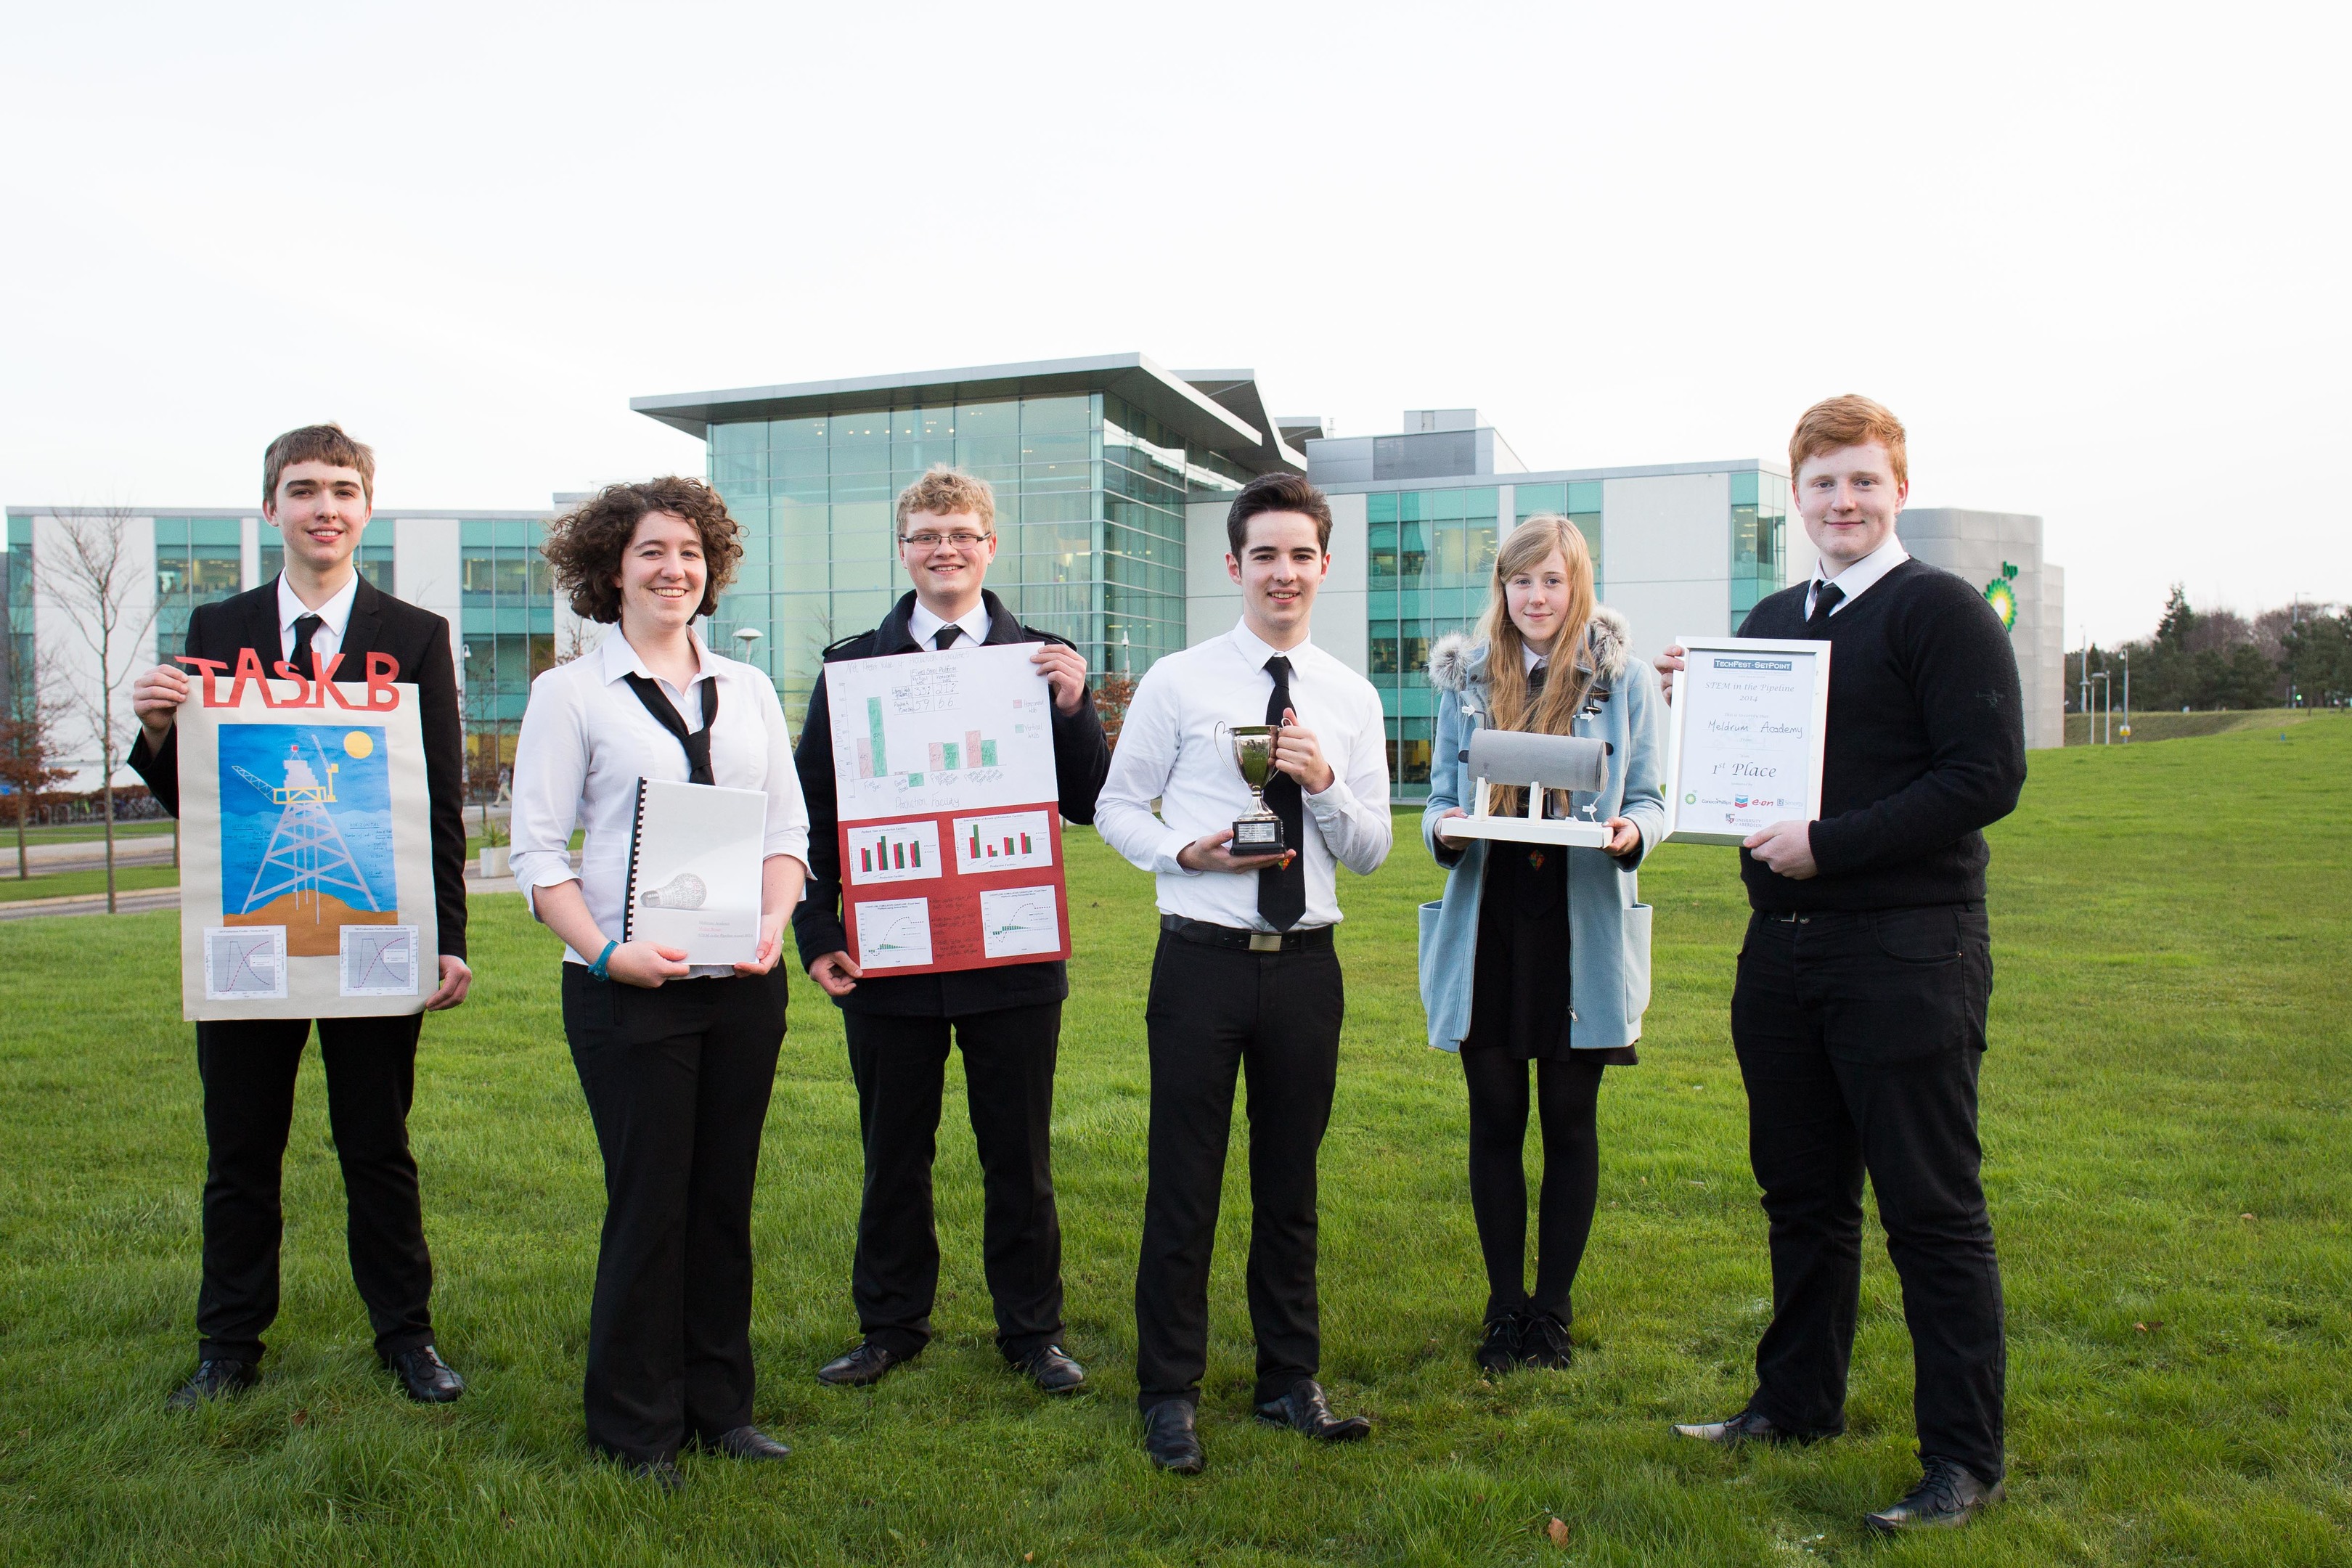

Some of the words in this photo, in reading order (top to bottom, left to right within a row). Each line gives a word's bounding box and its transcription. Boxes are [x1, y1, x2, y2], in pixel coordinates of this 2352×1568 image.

[2003, 560, 2018, 580] bp
[174, 648, 348, 709] TASK
[366, 652, 399, 711] B
[1760, 682, 1794, 693] Pipeline
[914, 686, 931, 696] 33%
[935, 682, 957, 695] 21%
[1708, 719, 1749, 732] Meldrum
[1760, 722, 1803, 739] Academy
[1732, 762, 1776, 777] Place
[894, 796, 927, 811] Production
[931, 790, 960, 808] Facility
